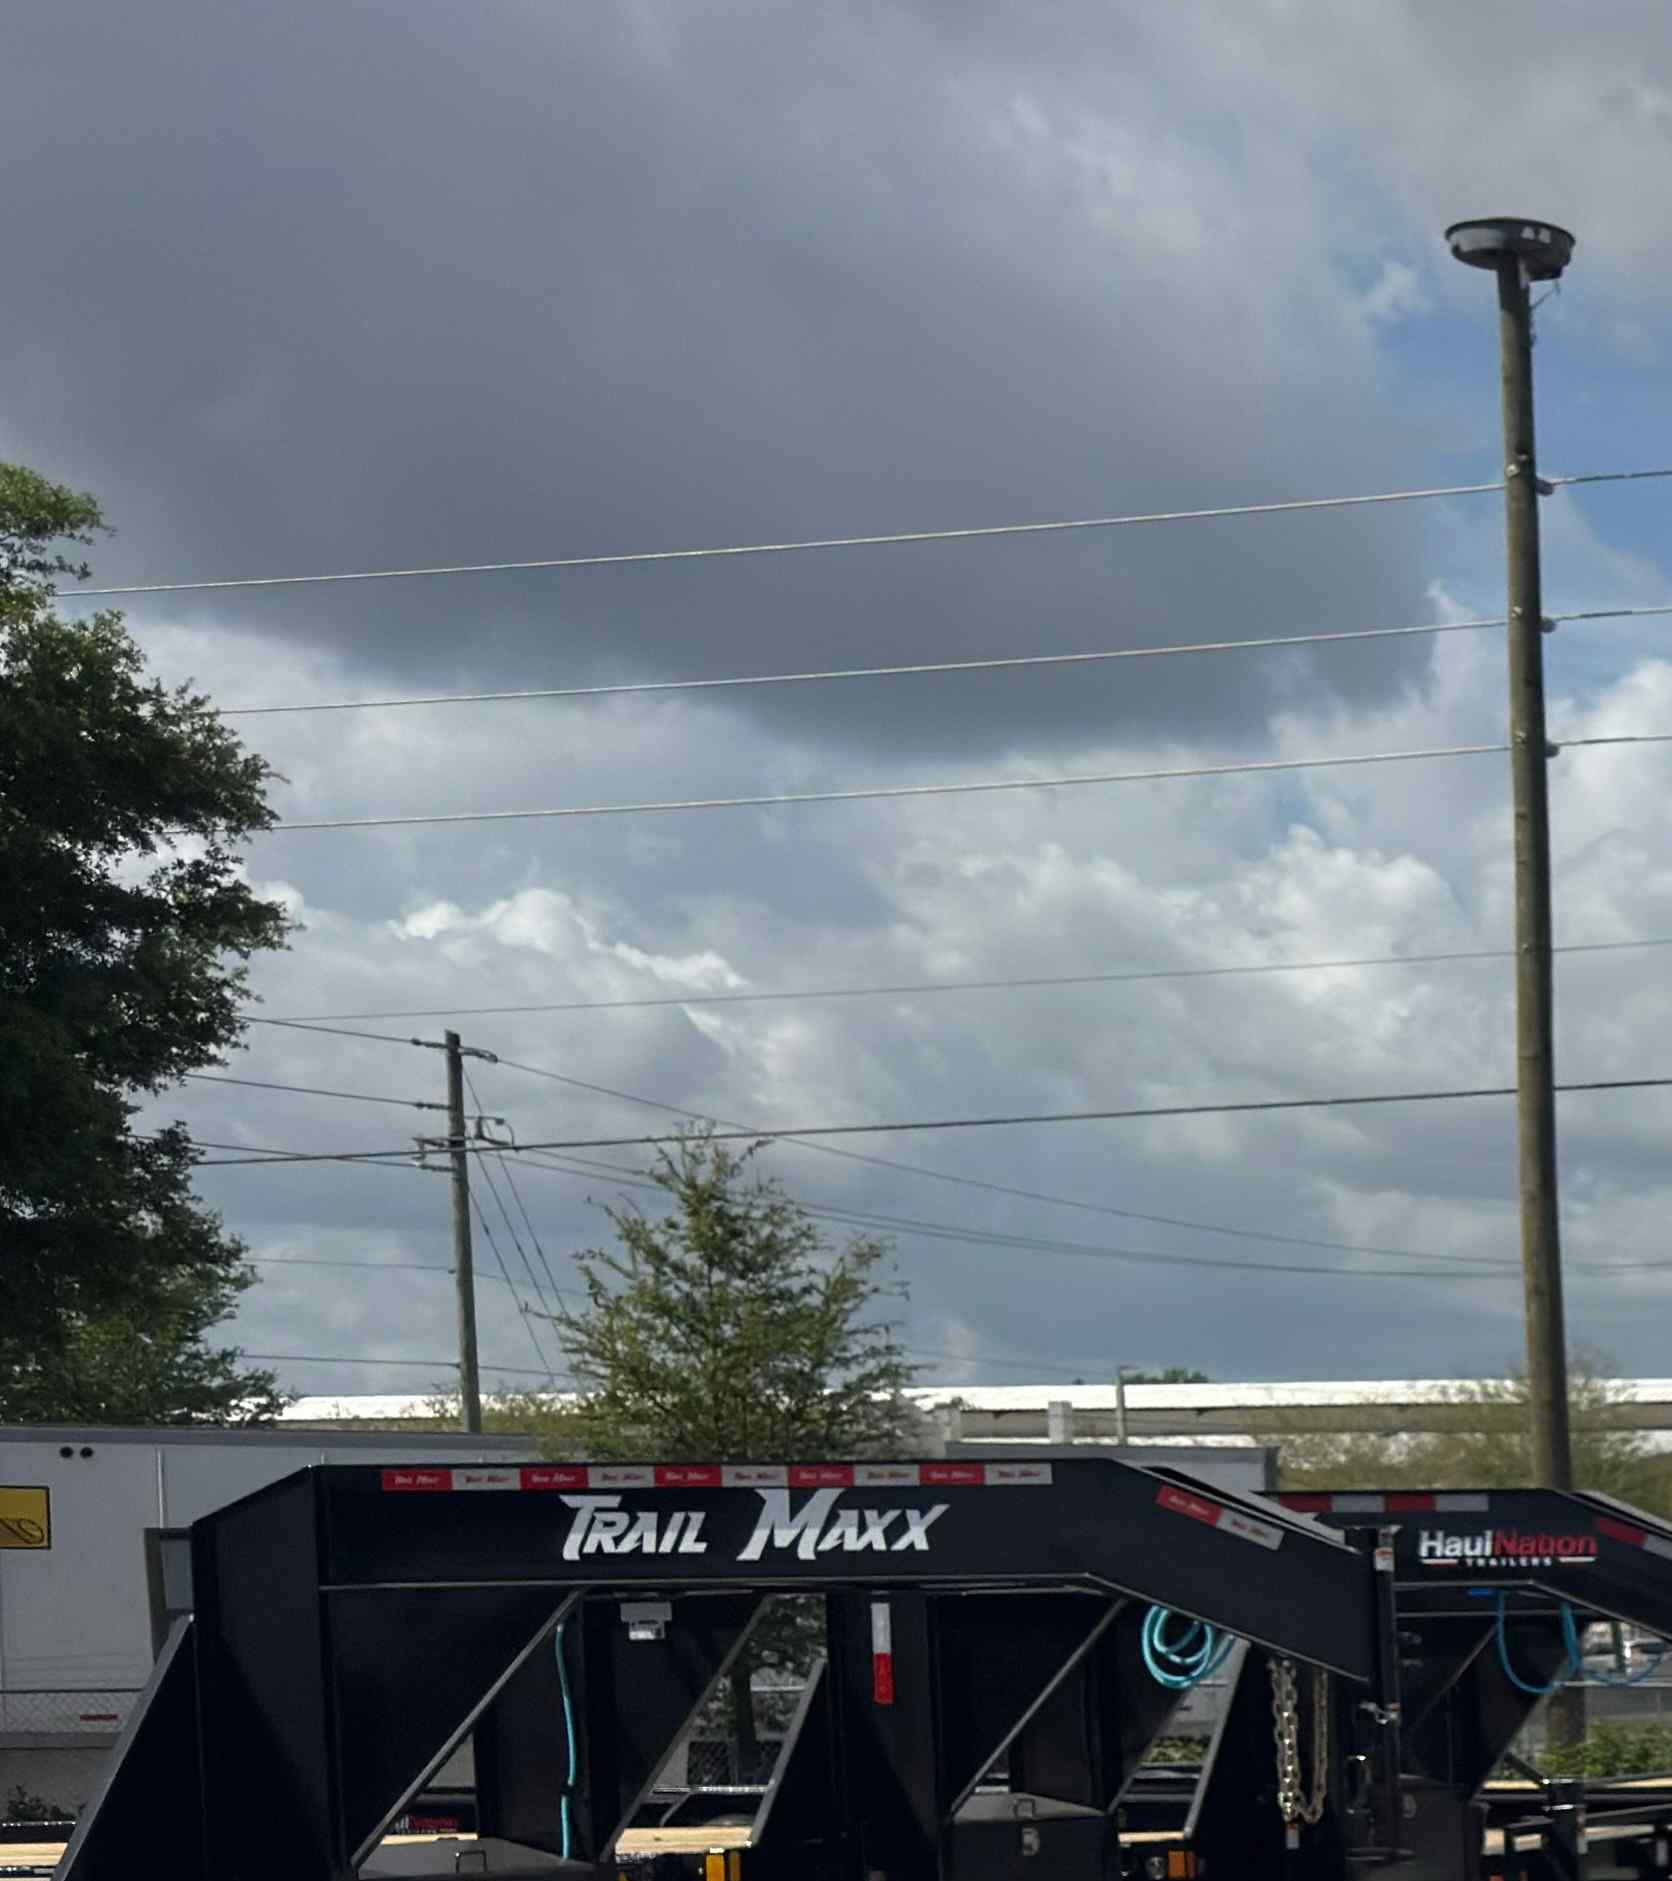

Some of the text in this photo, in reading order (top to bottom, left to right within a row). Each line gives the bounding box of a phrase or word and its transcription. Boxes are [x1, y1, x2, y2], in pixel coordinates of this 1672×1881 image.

[559, 1488, 950, 1560] TRAIL MAXX
[1466, 1557, 1552, 1566] TRAILERS
